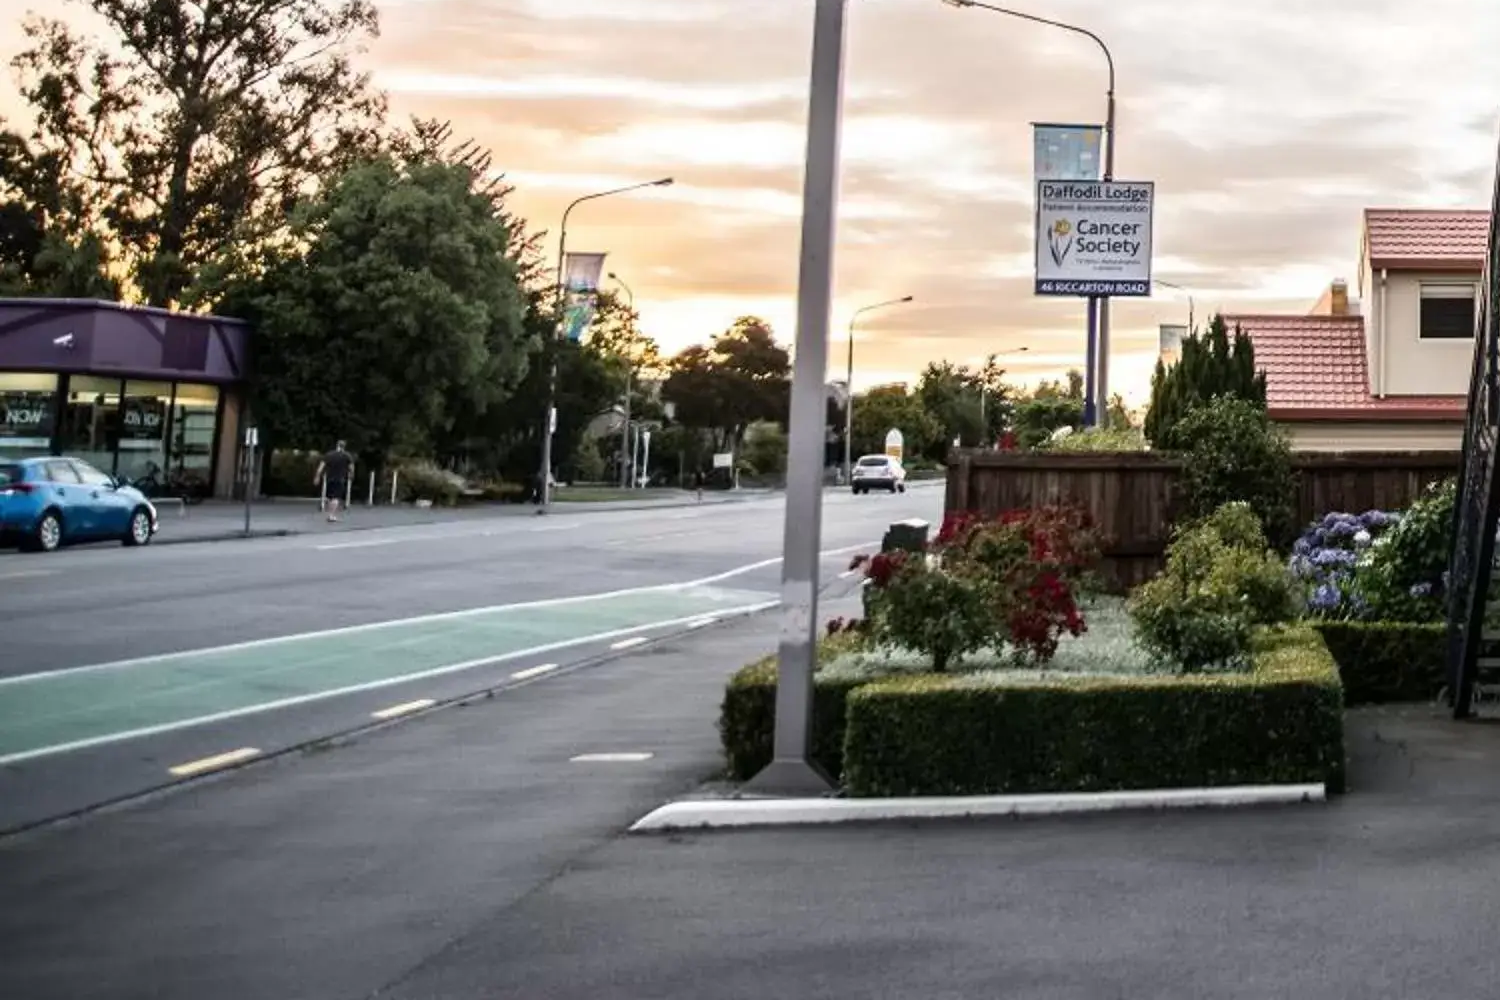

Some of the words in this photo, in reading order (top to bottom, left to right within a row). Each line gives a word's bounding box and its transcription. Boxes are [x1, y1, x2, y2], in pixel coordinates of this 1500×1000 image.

[1043, 185, 1101, 200] Daffodil
[1105, 185, 1149, 201] Lodge
[1076, 219, 1141, 236] Cancer
[1076, 236, 1141, 257] Society
[1116, 283, 1146, 293] ROAD
